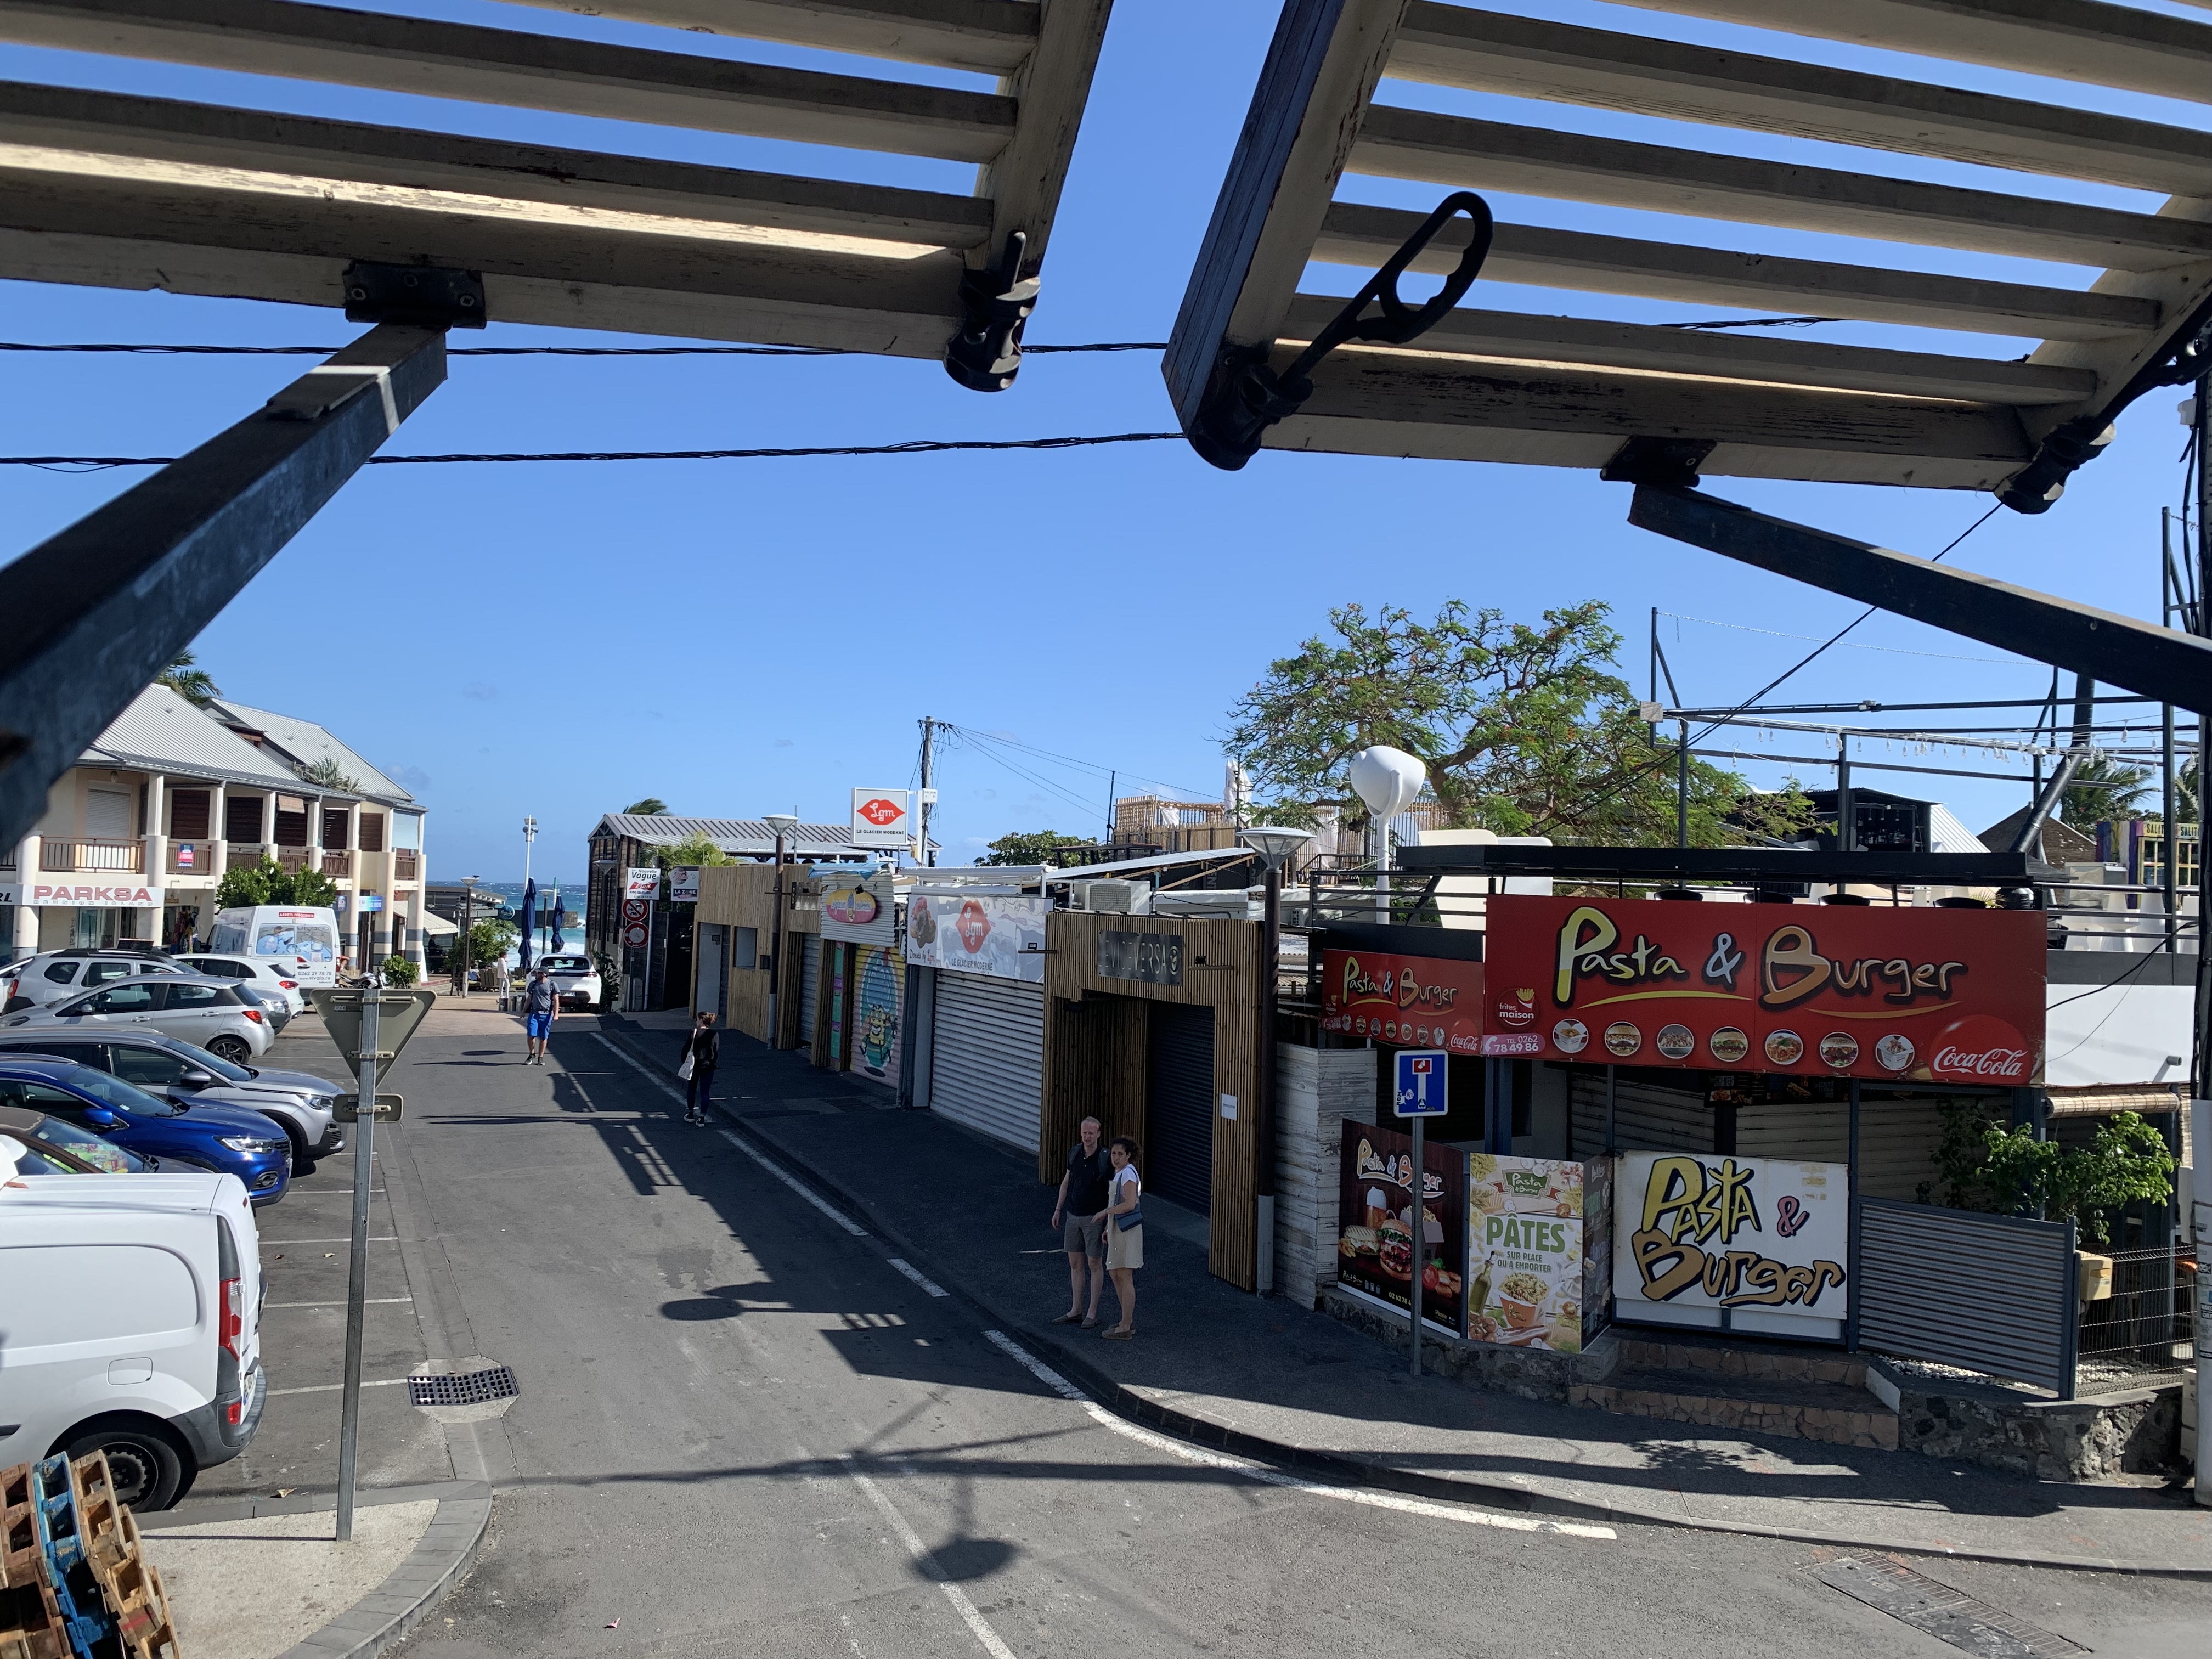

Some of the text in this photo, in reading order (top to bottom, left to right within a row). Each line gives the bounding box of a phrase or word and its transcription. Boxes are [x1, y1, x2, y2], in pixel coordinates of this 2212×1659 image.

[2147, 823, 2164, 834] SALIT
[2181, 826, 2199, 836] SALIT
[632, 871, 656, 881] Vague
[33, 885, 153, 901] PARKSA
[1556, 906, 1964, 1004] Pasta & Burger
[957, 959, 973, 968] GLACIER
[974, 960, 993, 971] MODERNE
[1343, 956, 1458, 1007] Pasta & Burger
[1499, 1002, 1516, 1011] frites
[1499, 1010, 1534, 1019] maison
[1494, 1042, 1539, 1052] 78 49 86
[1933, 1046, 2028, 1076] Coca-Cola
[1357, 1138, 1442, 1190] Pasta & Bger
[1512, 1173, 1543, 1188] Pasta
[1519, 1185, 1538, 1193] Burger
[1778, 1195, 1810, 1237] &
[1487, 1212, 1566, 1253] PÂTES
[1507, 1251, 1543, 1262] SUR PLACE
[1515, 1262, 1551, 1273] EMPORTER
[1632, 1228, 1846, 1307] Burger
[1389, 1291, 1395, 1299] 02
[1396, 1294, 1401, 1302] 62
